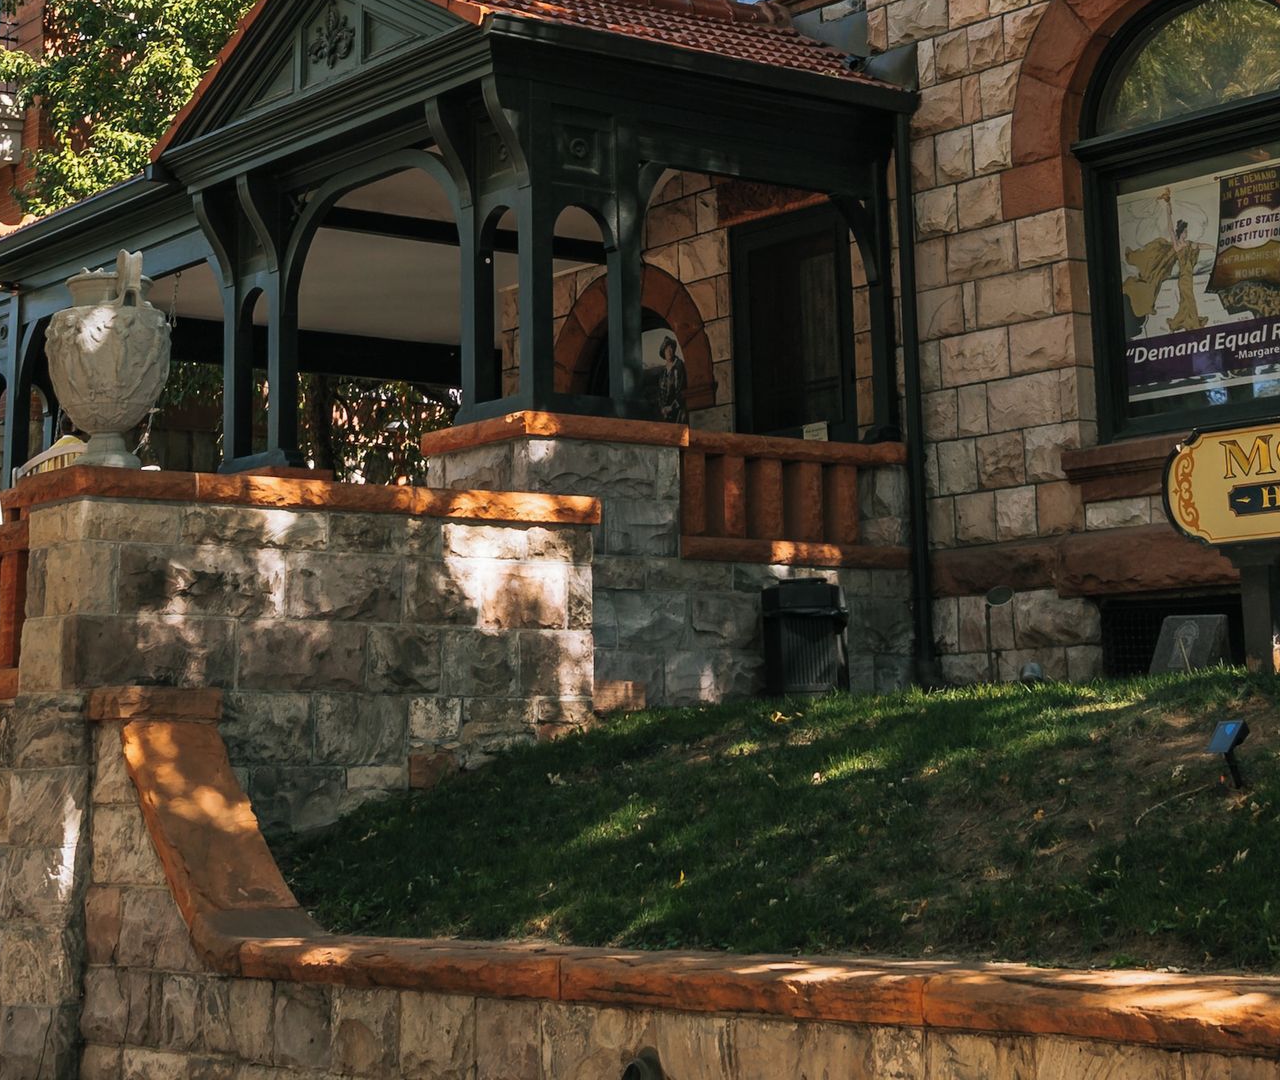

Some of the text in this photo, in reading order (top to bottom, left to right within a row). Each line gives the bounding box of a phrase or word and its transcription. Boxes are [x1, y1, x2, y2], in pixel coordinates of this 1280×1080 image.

[1243, 169, 1277, 184] DEMAND
[1237, 193, 1273, 208] TO THE
[1220, 217, 1252, 234] UNITED
[1214, 321, 1268, 352] Equal
